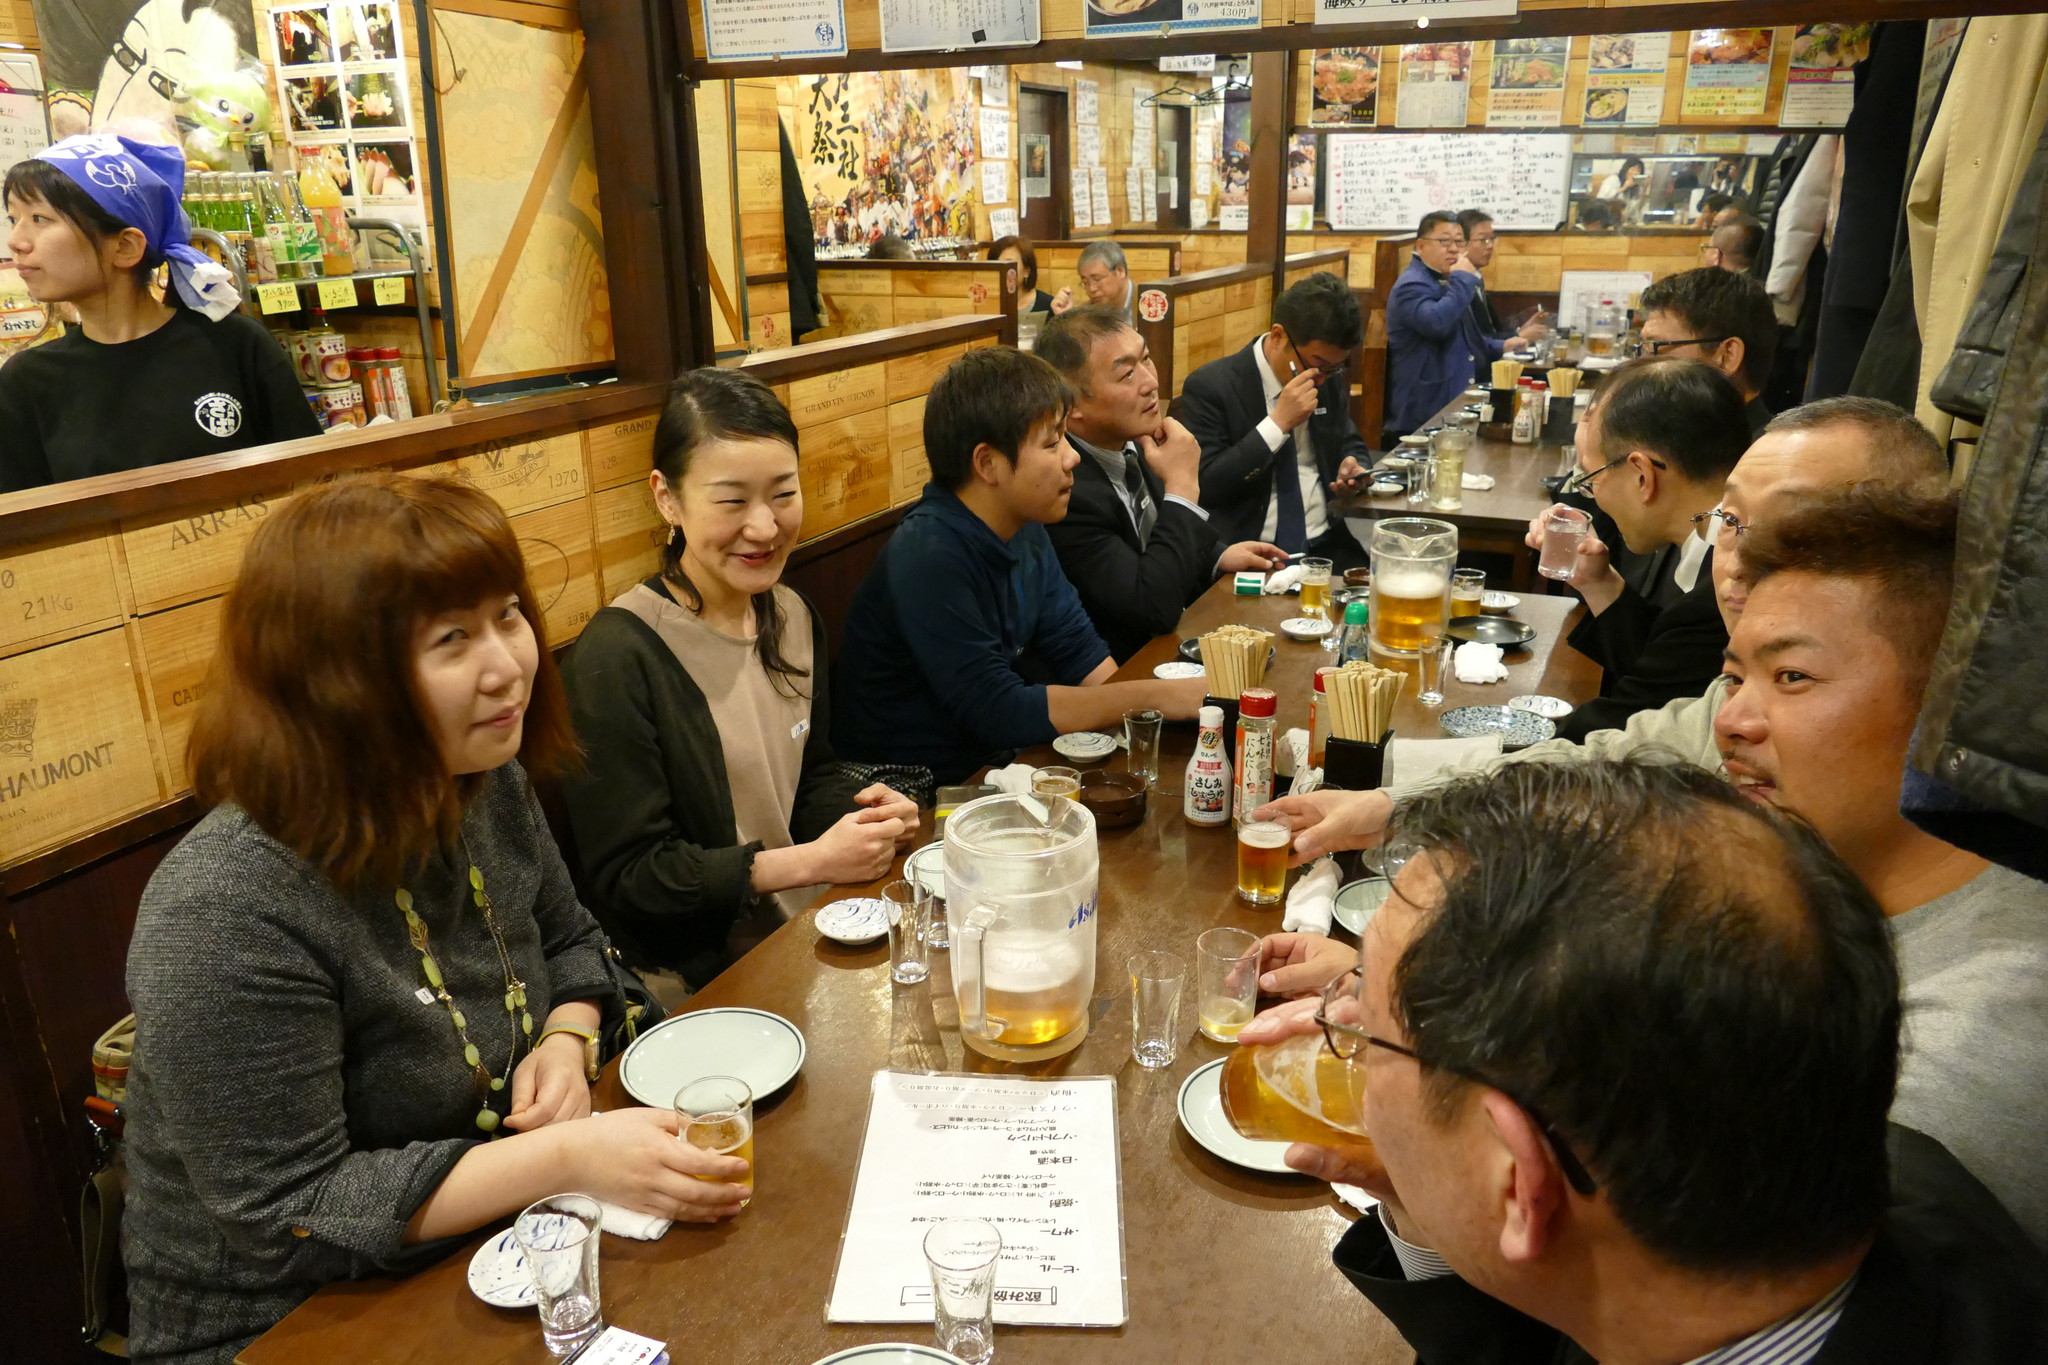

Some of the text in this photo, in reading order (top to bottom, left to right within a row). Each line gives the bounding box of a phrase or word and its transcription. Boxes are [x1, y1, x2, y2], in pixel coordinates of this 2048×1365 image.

[614, 419, 652, 437] GRAND
[548, 468, 578, 490] 1970
[170, 491, 270, 551] ARRAS
[1256, 735, 1266, 760] 七味
[1245, 737, 1255, 782] にんにく
[1190, 787, 1225, 801] しょうゆ
[1194, 777, 1223, 790] さしみ
